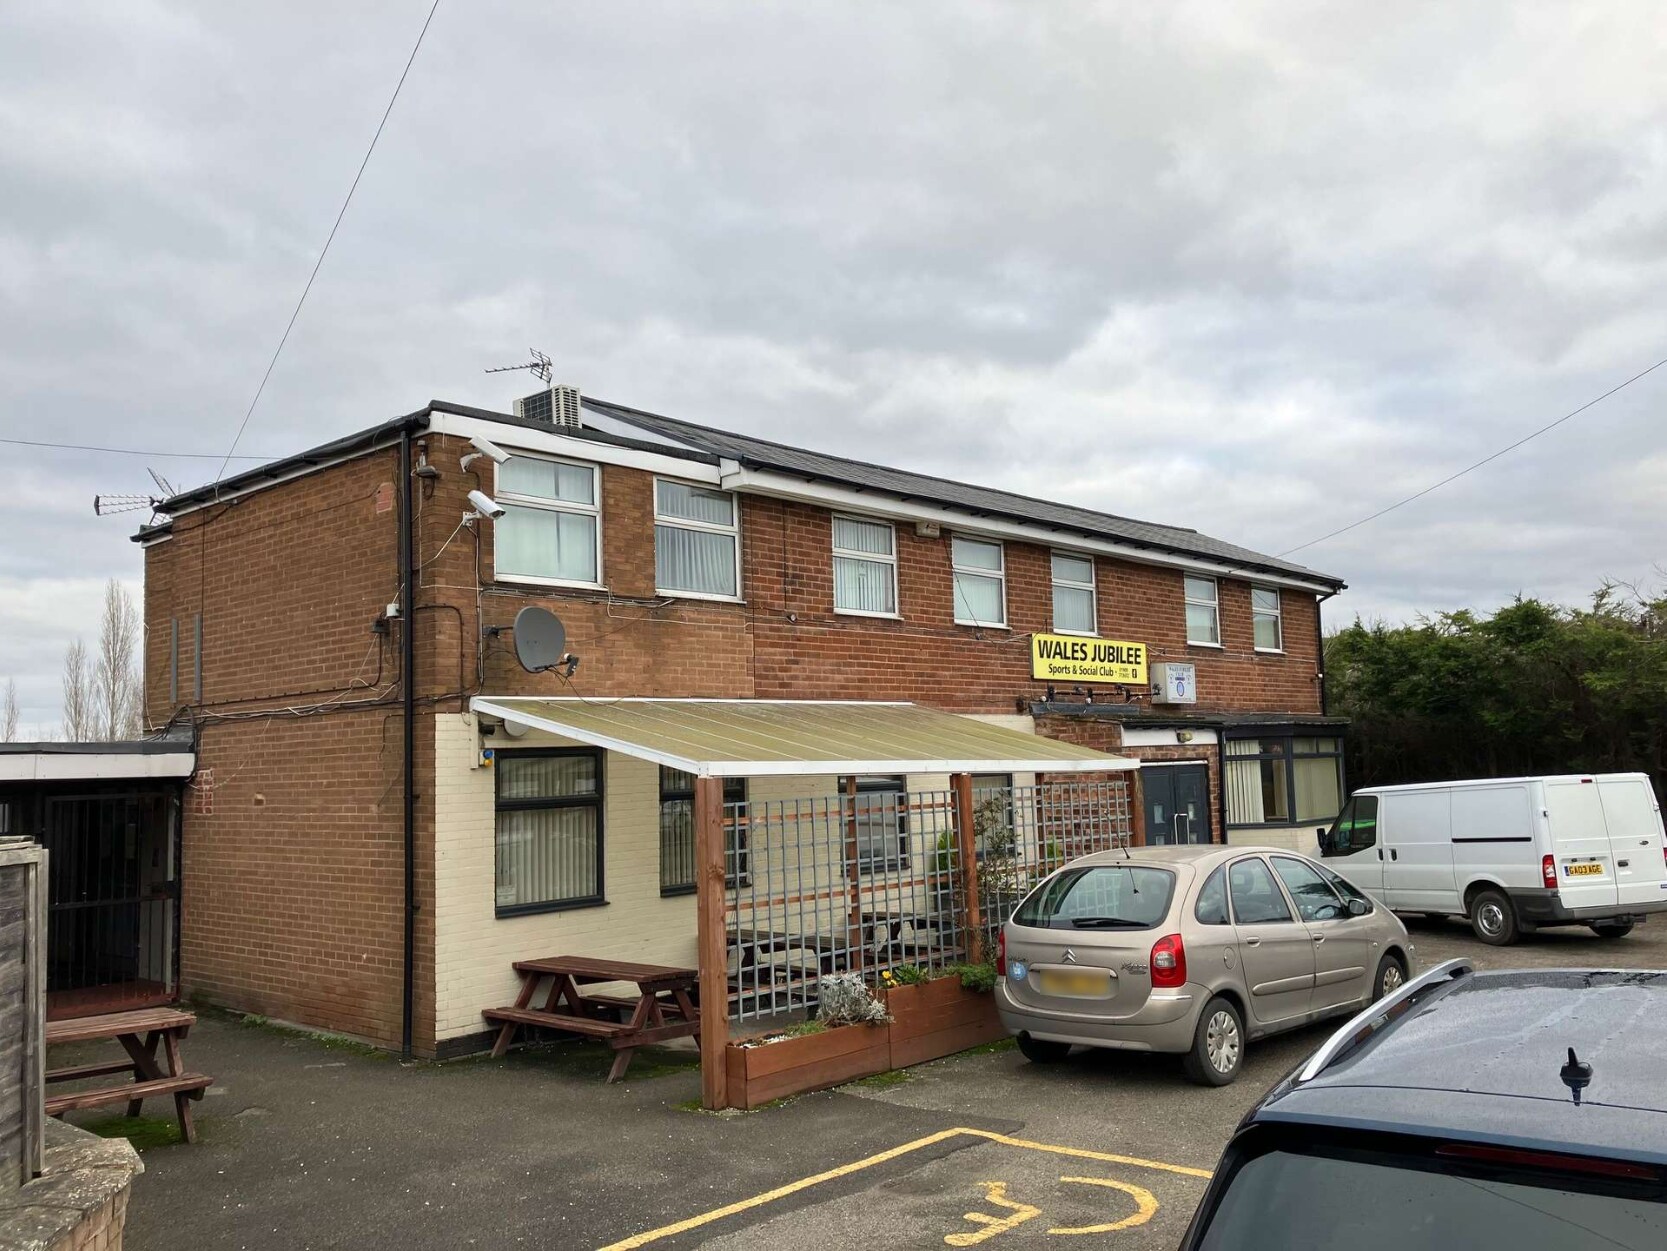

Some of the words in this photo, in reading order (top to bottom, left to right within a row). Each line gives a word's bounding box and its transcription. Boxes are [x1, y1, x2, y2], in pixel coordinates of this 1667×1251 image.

[1038, 640, 1087, 662] WALES
[1091, 643, 1142, 665] JUBILEE
[1048, 663, 1071, 676] Sports
[1072, 665, 1078, 675] &
[1079, 665, 1098, 676] Social
[1100, 666, 1114, 677] Club
[1588, 864, 1602, 873] AGE
